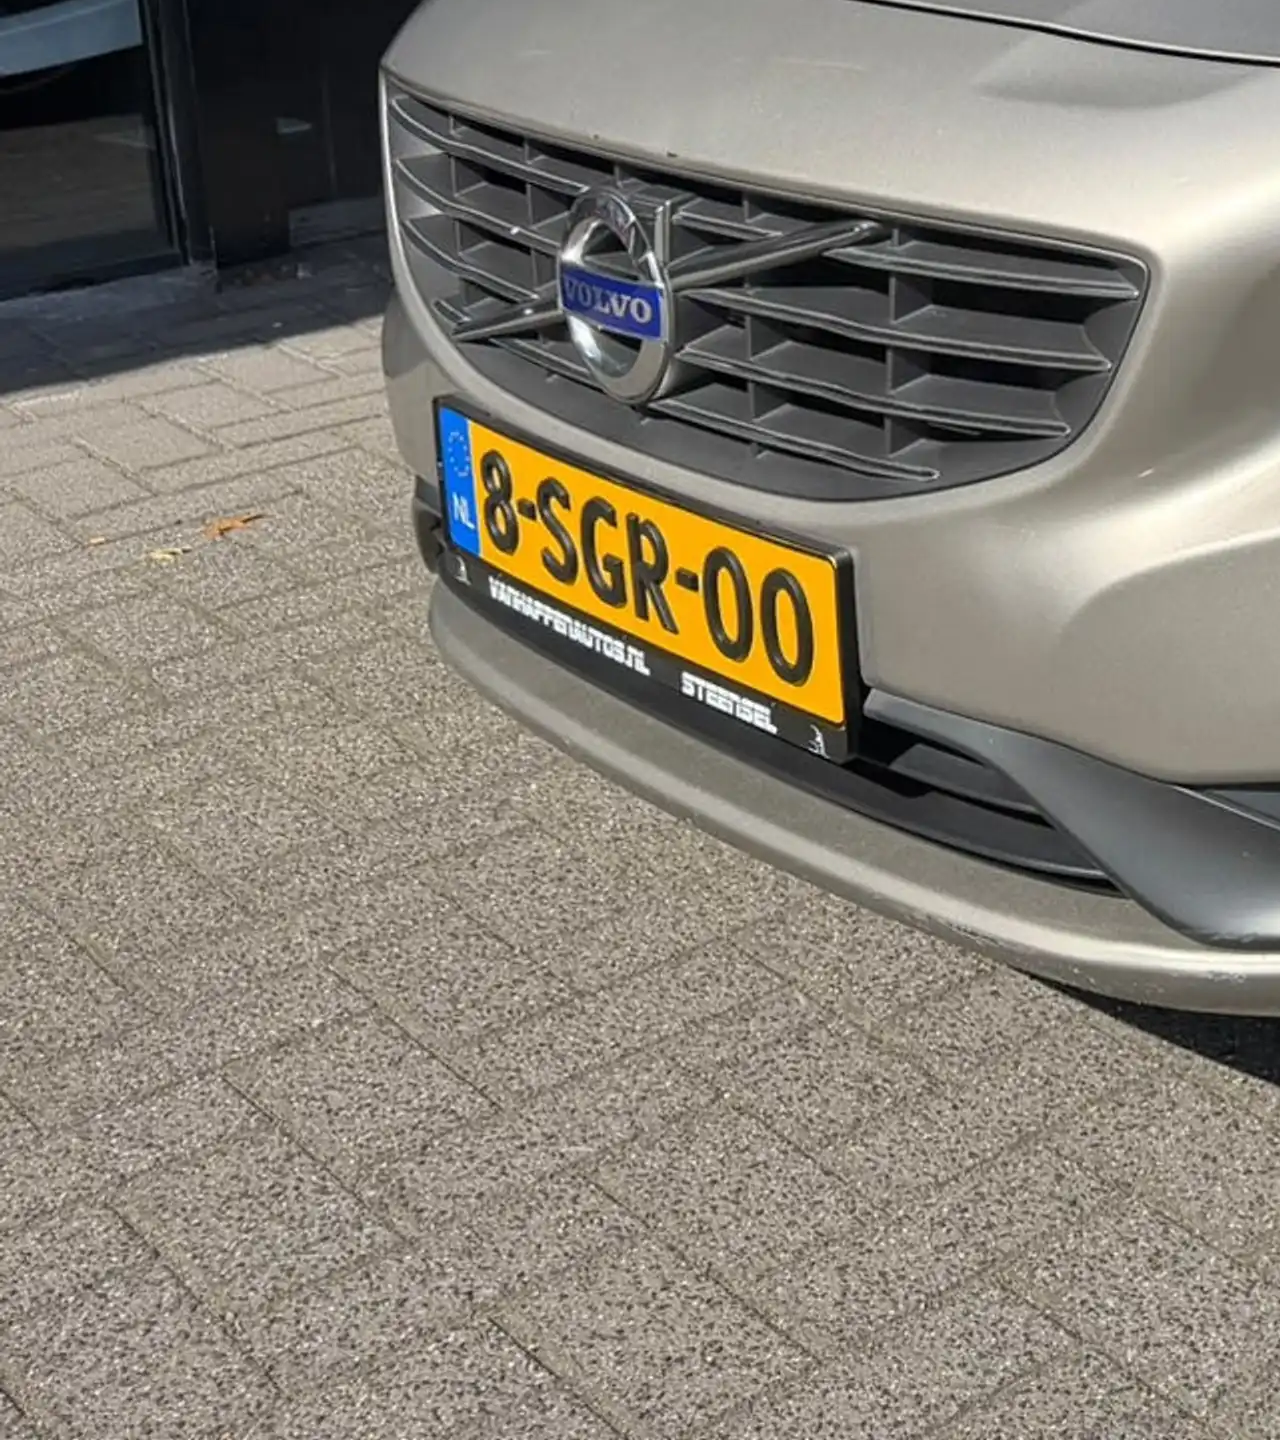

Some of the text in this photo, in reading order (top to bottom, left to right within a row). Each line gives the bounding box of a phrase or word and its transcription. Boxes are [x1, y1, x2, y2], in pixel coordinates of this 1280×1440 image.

[563, 274, 653, 325] VOLVO
[453, 491, 475, 531] NL
[480, 448, 815, 688] 8-SGR-00
